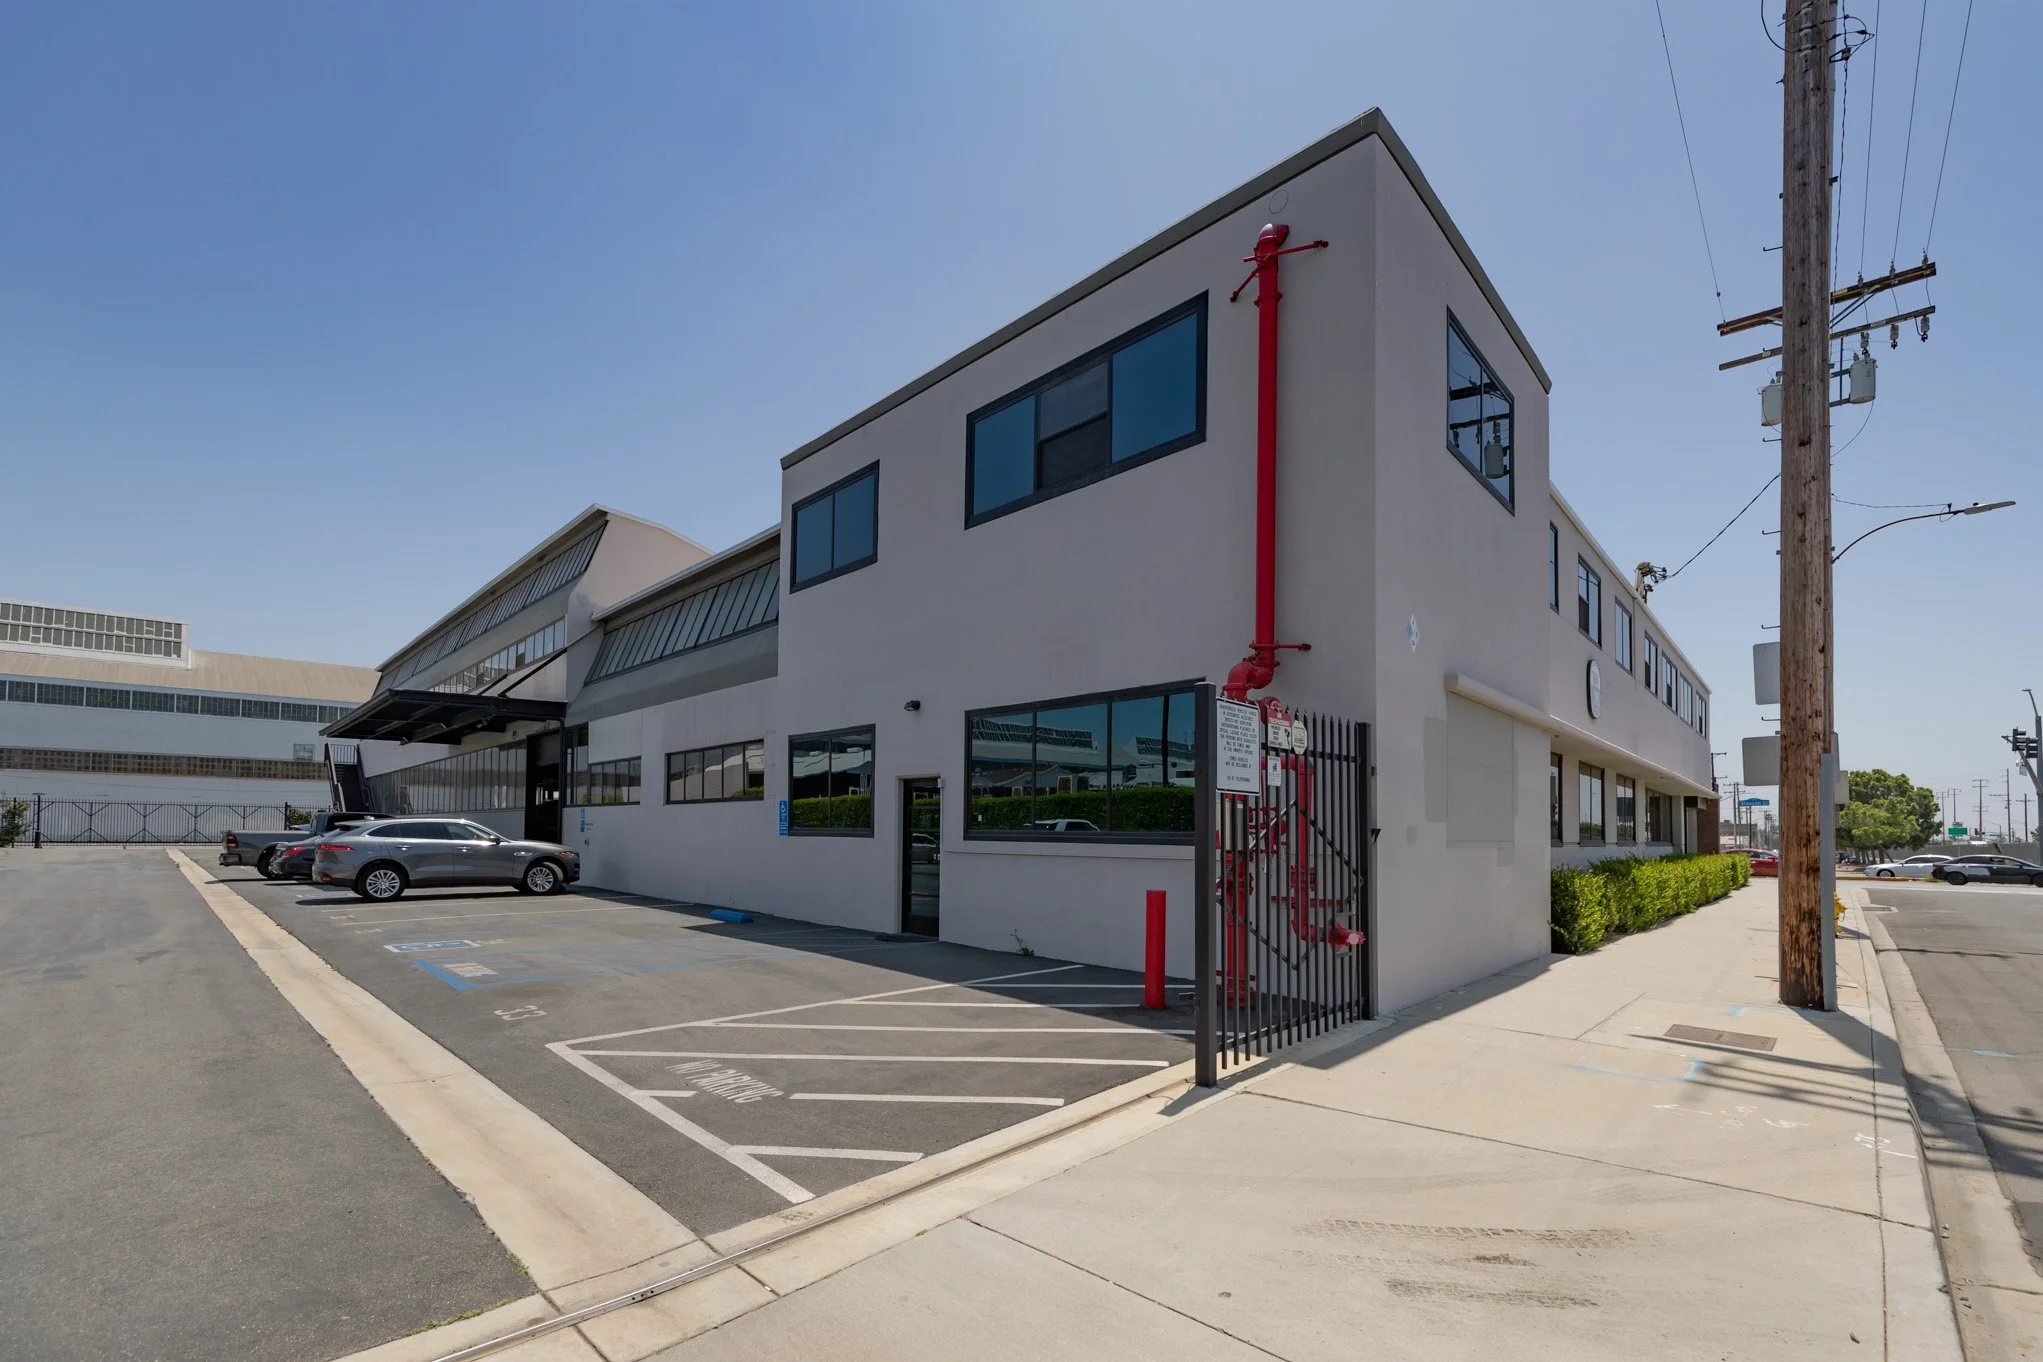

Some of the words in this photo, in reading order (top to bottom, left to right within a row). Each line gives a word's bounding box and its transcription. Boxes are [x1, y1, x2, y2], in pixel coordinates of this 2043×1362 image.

[494, 1005, 547, 1021] 33
[664, 1059, 723, 1074] NO
[685, 1068, 785, 1104] PARKING
